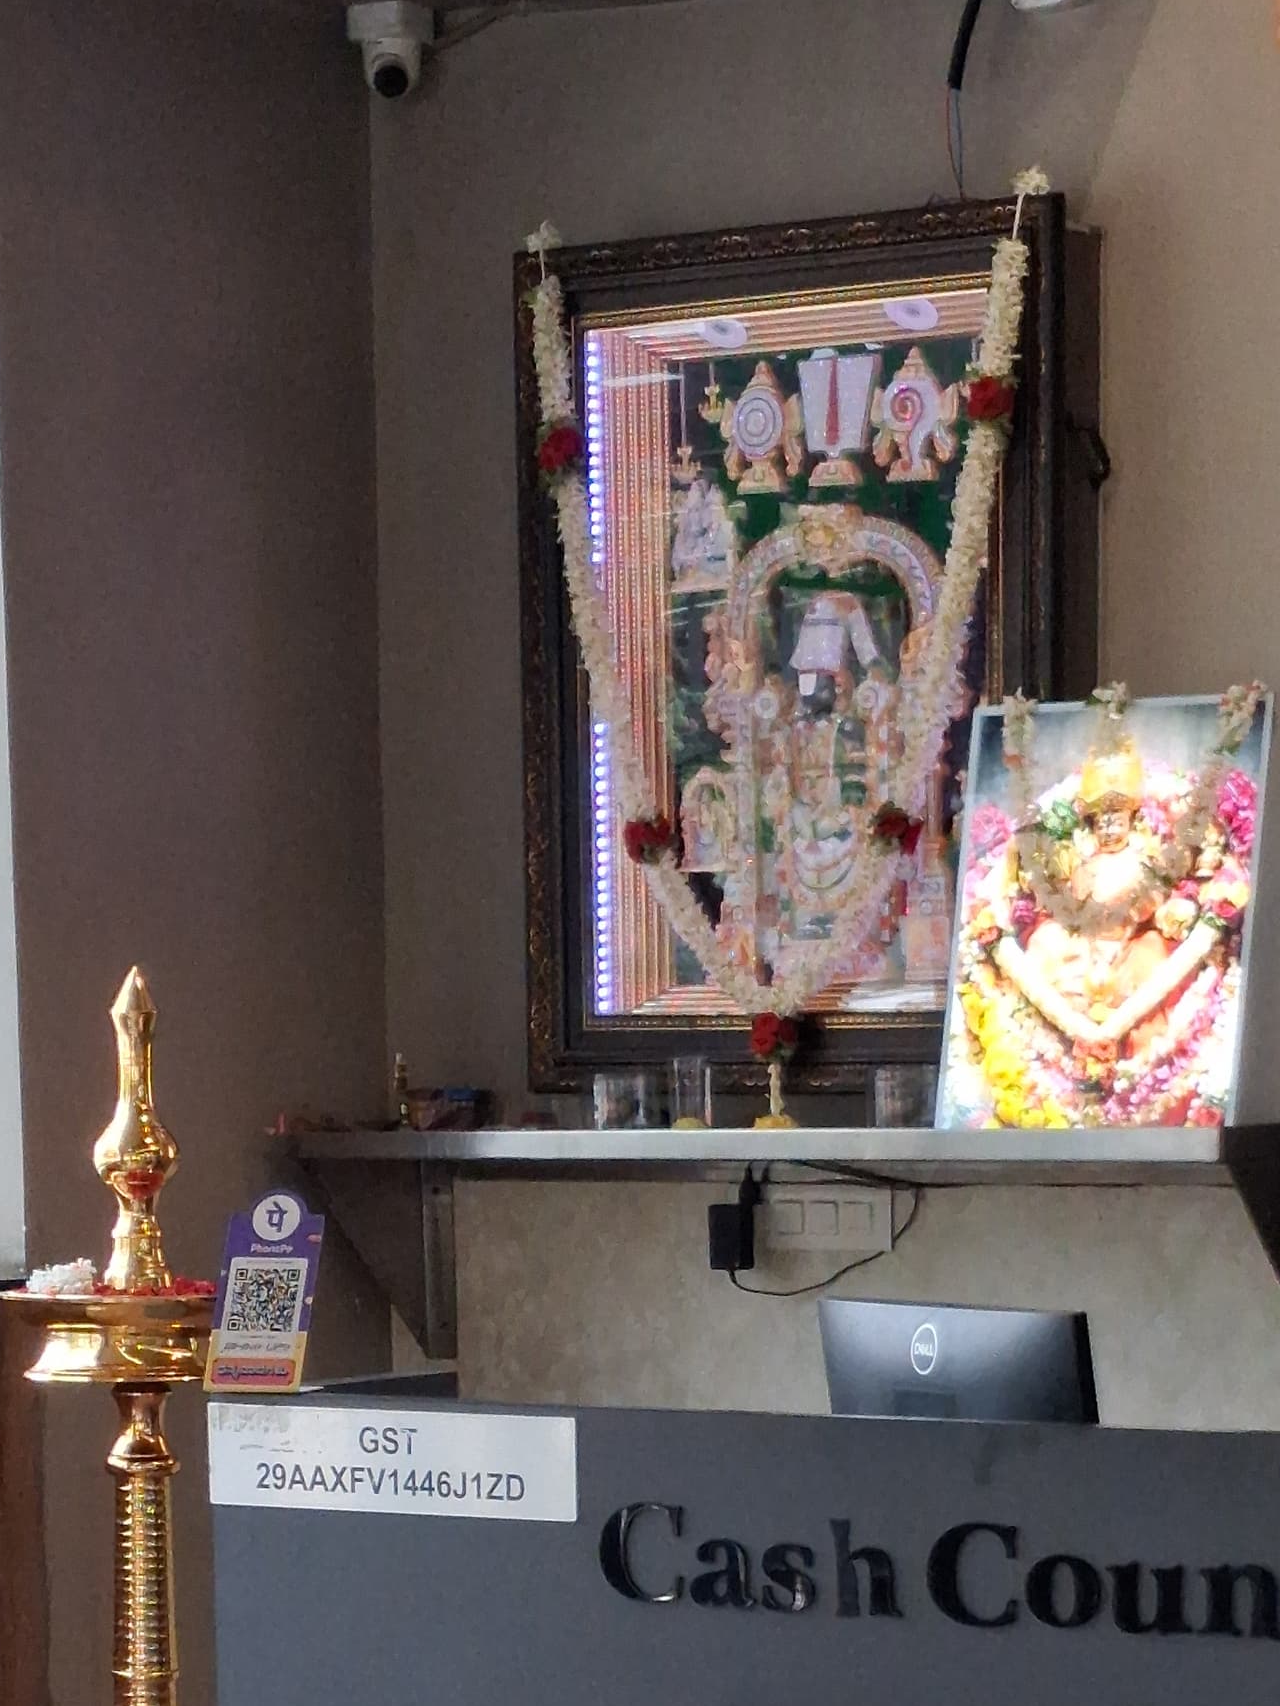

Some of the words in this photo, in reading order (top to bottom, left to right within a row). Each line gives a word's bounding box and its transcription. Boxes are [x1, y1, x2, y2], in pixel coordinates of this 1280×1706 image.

[359, 1426, 418, 1455] GST
[256, 1462, 526, 1502] 29AAXFV1446J1ZD
[598, 1502, 904, 1619] Cash
